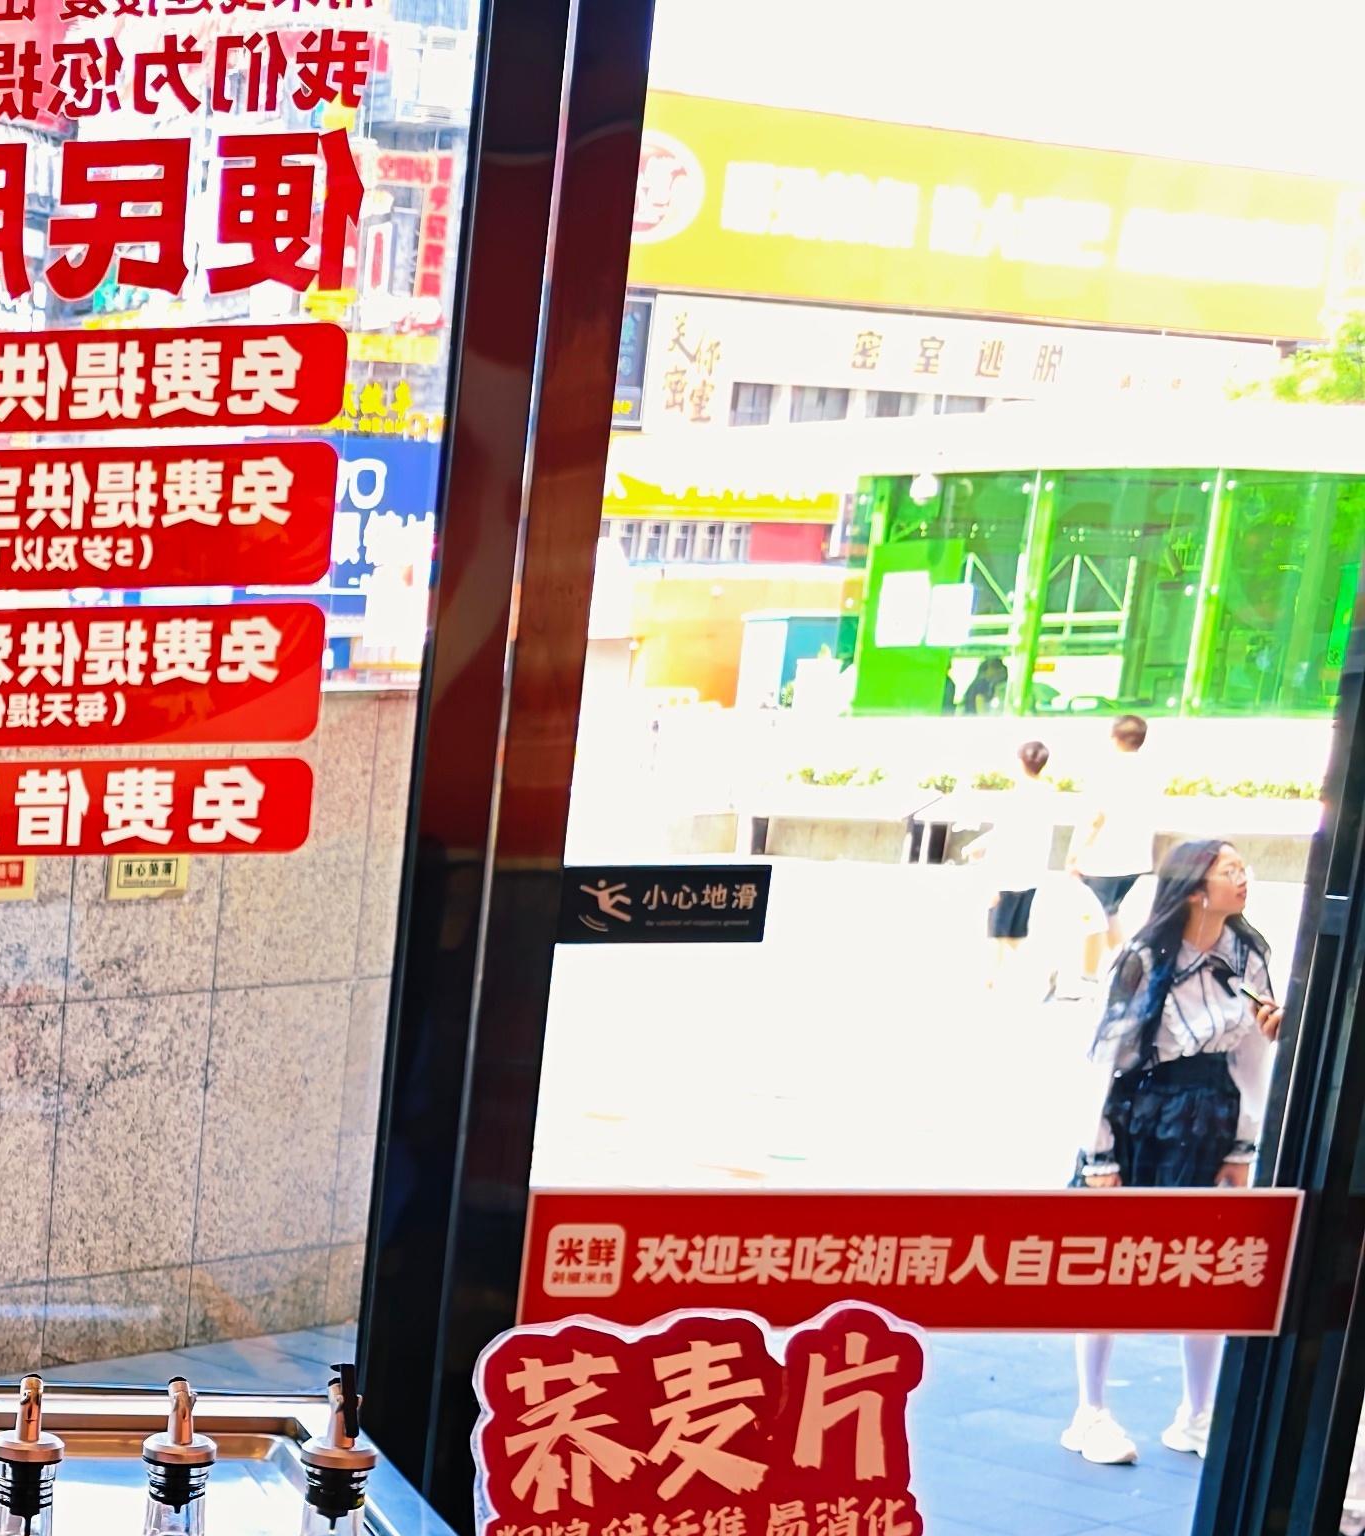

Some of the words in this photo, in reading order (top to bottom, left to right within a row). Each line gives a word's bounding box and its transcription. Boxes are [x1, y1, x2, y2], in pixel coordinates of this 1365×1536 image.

[851, 330, 1063, 382] 密室逃脱
[641, 883, 758, 911] 小心地滑
[555, 1236, 617, 1269] 米鲜
[632, 1234, 1269, 1290] 欢迎来吃湖南人自己的米线
[505, 1332, 900, 1514] 荞麦片
